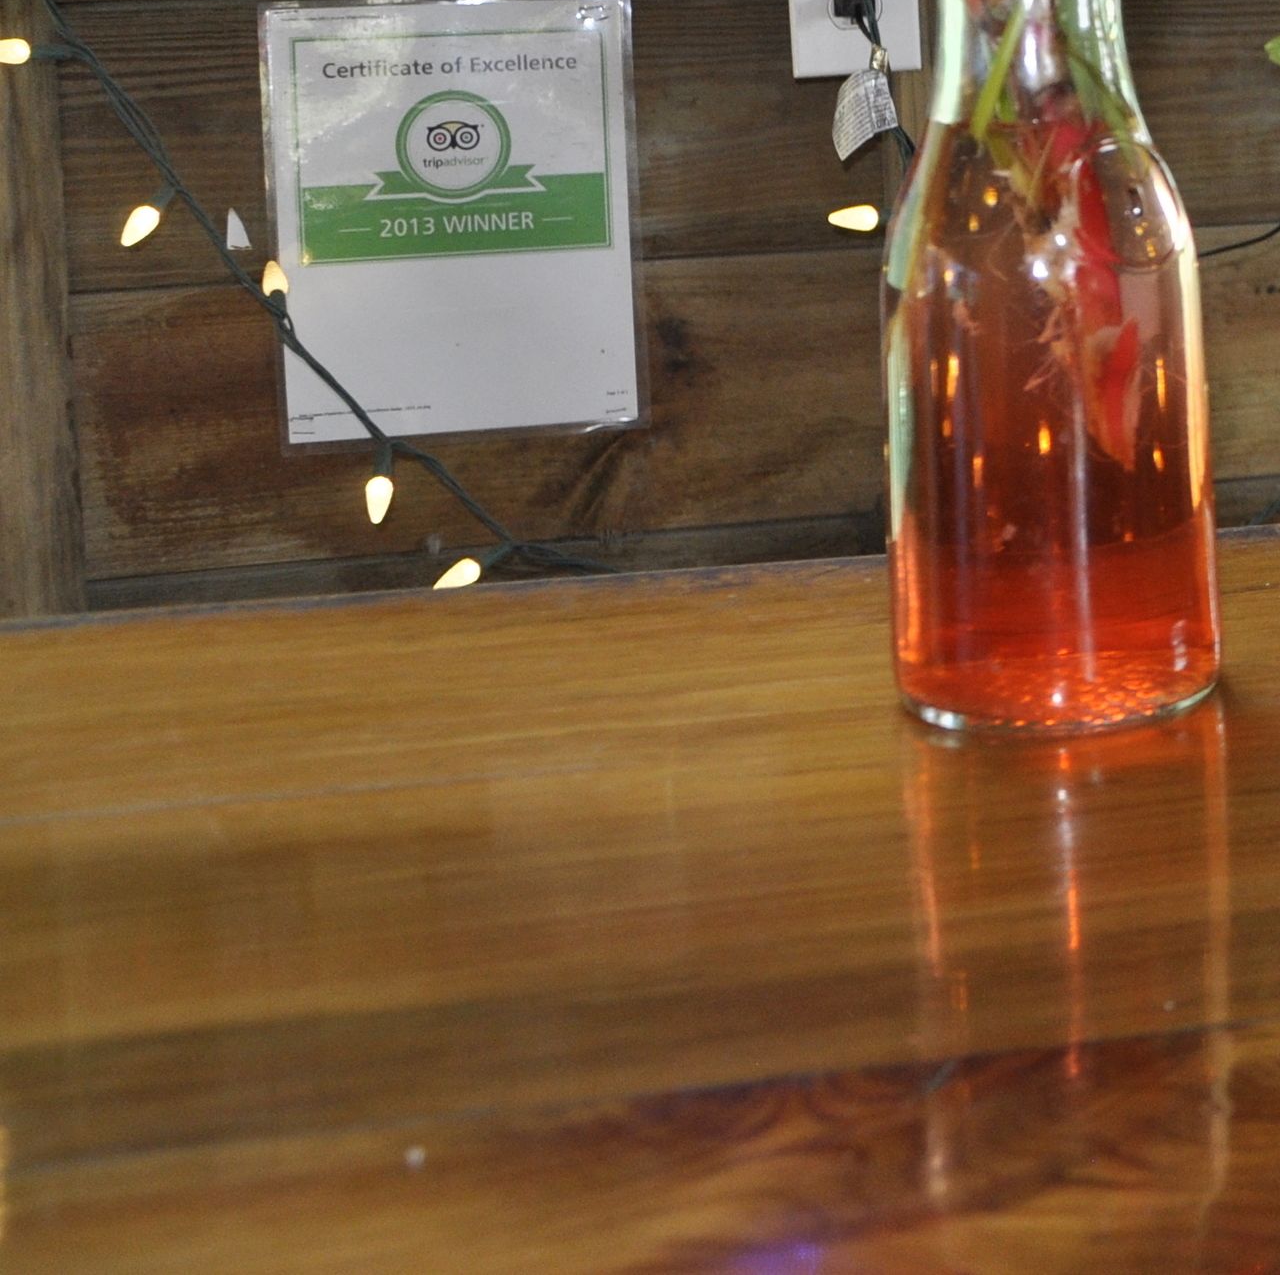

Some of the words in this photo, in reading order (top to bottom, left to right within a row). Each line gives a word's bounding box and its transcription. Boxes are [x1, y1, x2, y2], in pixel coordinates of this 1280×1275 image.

[322, 59, 434, 79] Certificate
[441, 56, 463, 75] of
[469, 54, 578, 74] Excellence
[423, 156, 485, 170] tripadvisor
[379, 217, 436, 238] 2013
[442, 211, 535, 234] WINNER
